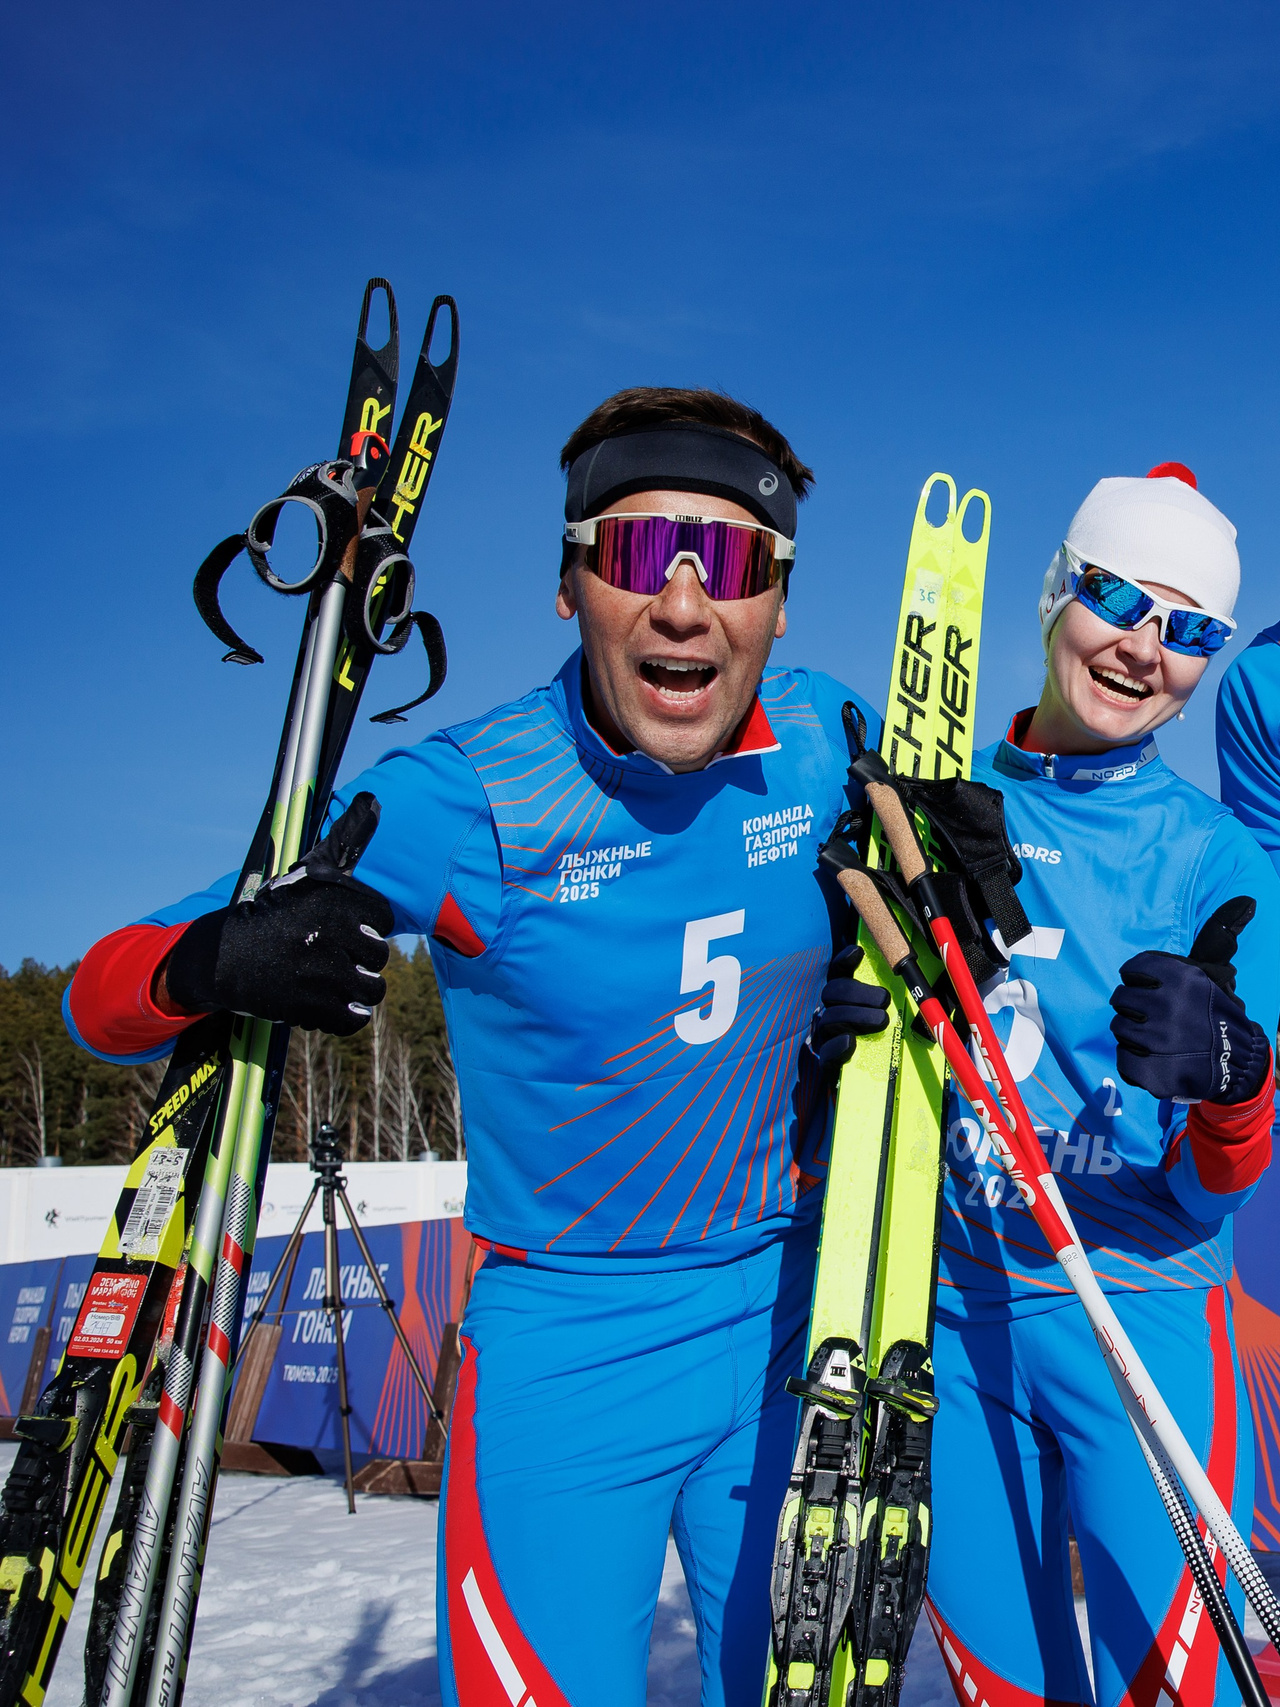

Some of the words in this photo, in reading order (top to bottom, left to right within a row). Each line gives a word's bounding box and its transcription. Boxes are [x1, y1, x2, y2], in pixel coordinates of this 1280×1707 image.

[742, 803, 814, 836] КОМАНДА
[744, 820, 811, 852] ГАЗПРОМ
[557, 840, 652, 870] ЛЫЖНЫЕ
[747, 840, 798, 869] НЕФТИ
[559, 862, 621, 886] ГОНКИ
[559, 881, 600, 904] 2025
[674, 908, 745, 1045] 5
[149, 1084, 190, 1136] SPEED
[190, 1049, 222, 1094] MAX
[964, 1170, 1025, 1210] 202
[1060, 1251, 1080, 1267] 322
[73, 1335, 104, 1344] 02.03.2024
[283, 1364, 316, 1382] ТЮМЕНЬ
[316, 1366, 339, 1384] 2025
[169, 1456, 211, 1650] AVANTI
[108, 1488, 160, 1690] AVANTI
[159, 1650, 176, 1707] PLUS
